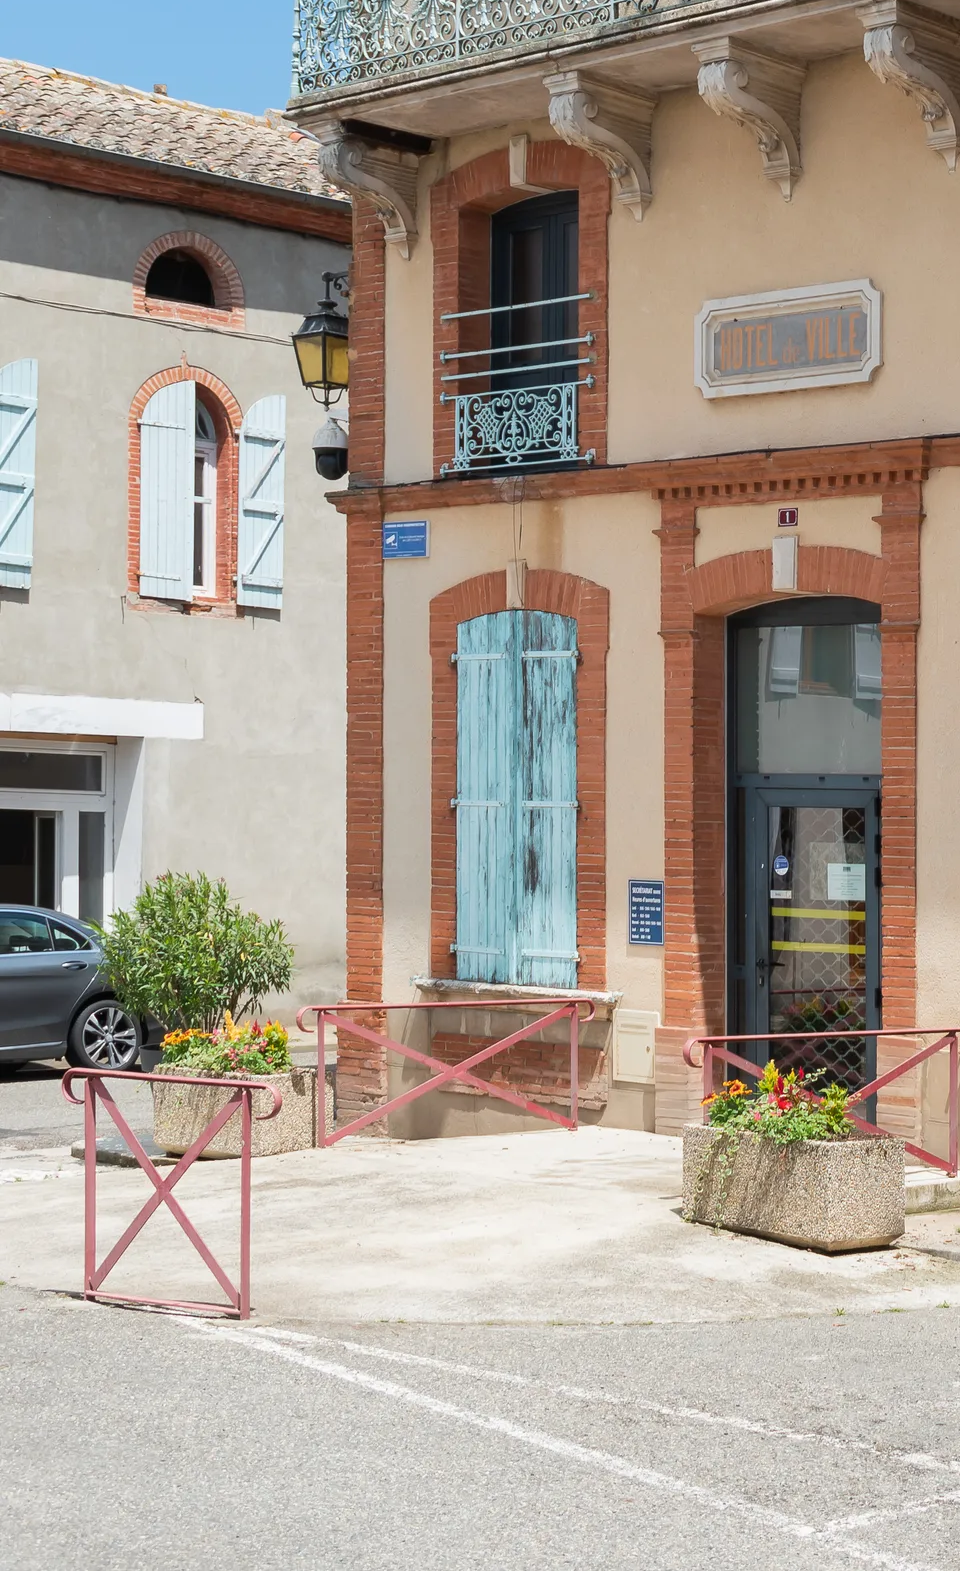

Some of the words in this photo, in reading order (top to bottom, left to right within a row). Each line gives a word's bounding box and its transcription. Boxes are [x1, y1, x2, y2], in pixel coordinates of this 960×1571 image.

[720, 323, 778, 371] HOTEL
[781, 337, 800, 364] de
[806, 312, 862, 362] VILLE
[785, 511, 790, 523] 1
